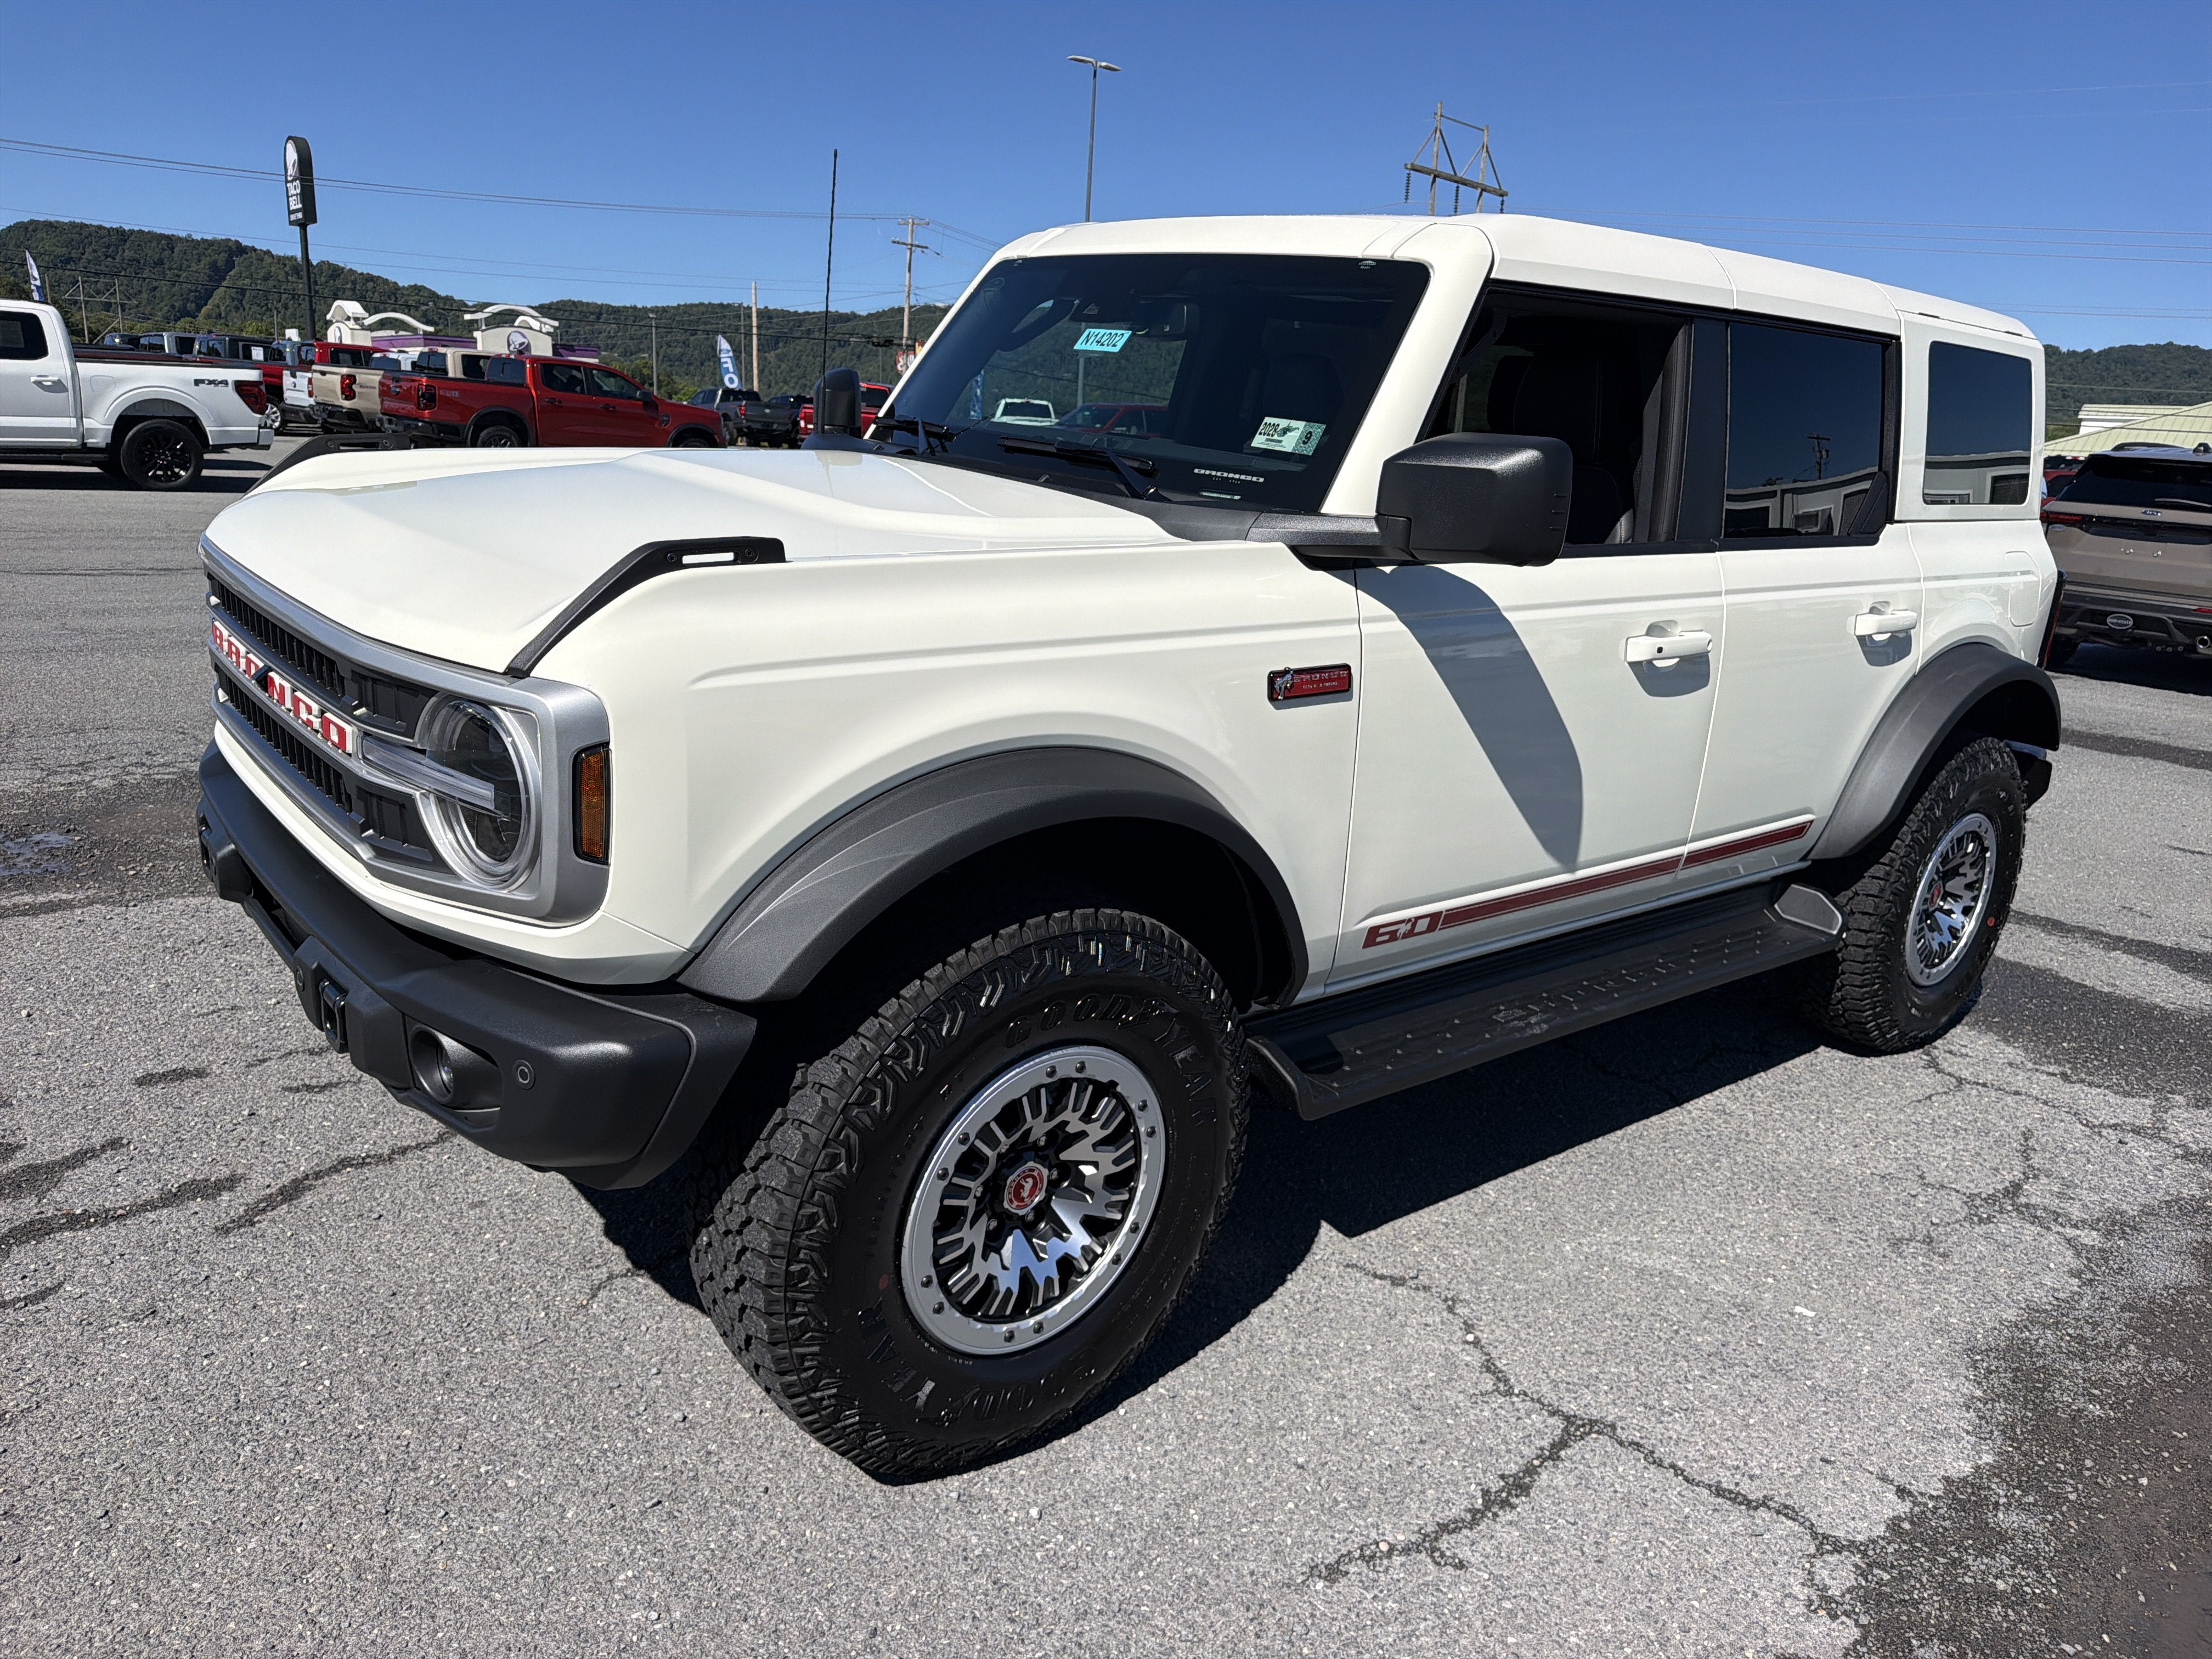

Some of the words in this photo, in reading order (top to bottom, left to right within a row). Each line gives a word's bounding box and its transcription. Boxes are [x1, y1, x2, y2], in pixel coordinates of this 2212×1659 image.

[287, 180, 301, 196] TACO
[289, 194, 302, 211] BELL
[1080, 330, 1125, 347] N14202
[1258, 421, 1280, 437] 2028
[1302, 431, 1313, 445] 9
[1193, 469, 1265, 482] BRONCO
[1294, 671, 1347, 682] BRONCO
[212, 620, 353, 754] BRONCO
[1362, 911, 1444, 949] 60
[1005, 992, 1219, 1128] GOODYEAR
